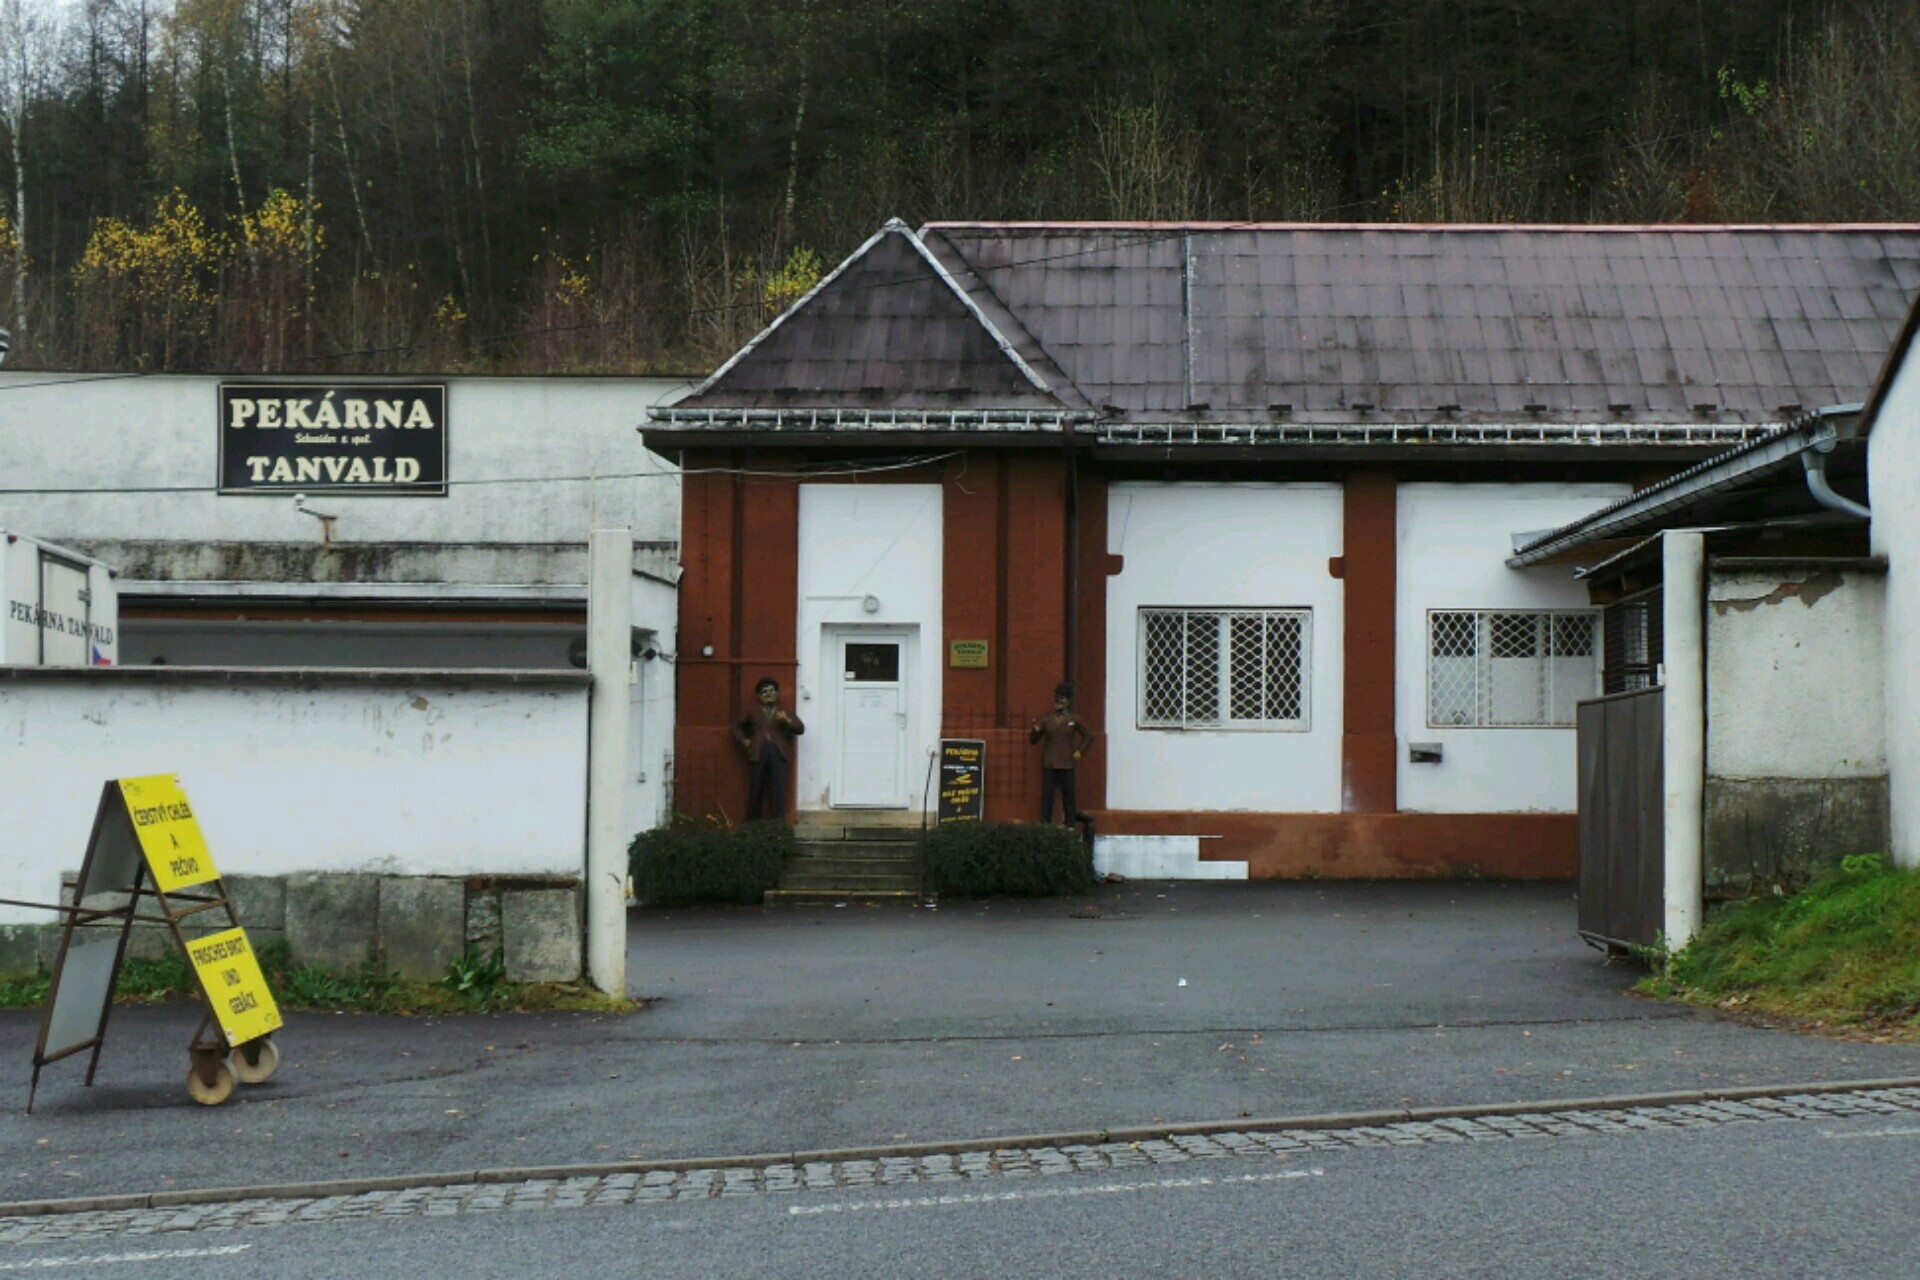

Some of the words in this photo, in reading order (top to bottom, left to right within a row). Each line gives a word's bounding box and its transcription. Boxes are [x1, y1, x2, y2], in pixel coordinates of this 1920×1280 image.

[230, 390, 434, 429] PEKÁRNA
[246, 456, 421, 483] TANVALD
[10, 600, 64, 633] PEKÁRNA
[67, 617, 113, 645] TANVALD
[169, 832, 180, 849] A
[192, 942, 229, 967] FRISCHES
